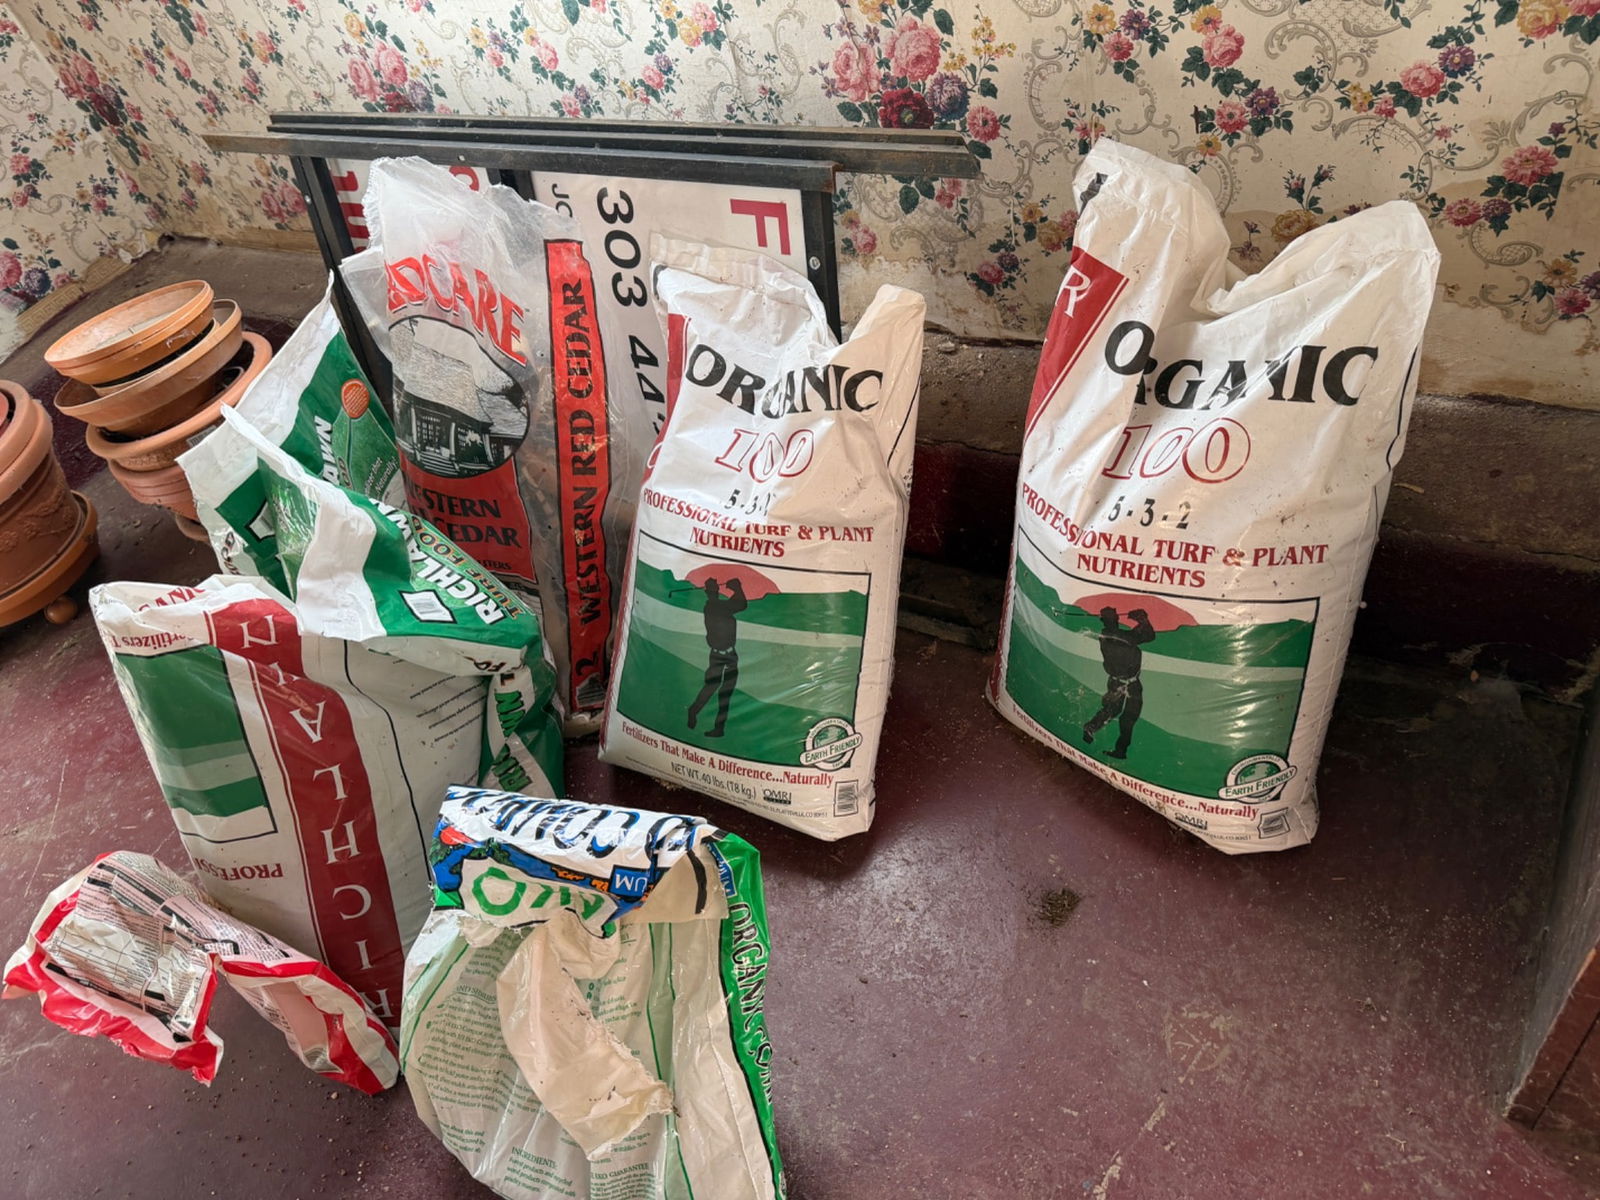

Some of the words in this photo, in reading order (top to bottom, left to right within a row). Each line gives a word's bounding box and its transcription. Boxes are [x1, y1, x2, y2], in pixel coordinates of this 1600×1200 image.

[596, 186, 649, 308] 303
[562, 278, 595, 398] CEDAR
[568, 410, 597, 477] RED
[714, 428, 815, 483] 100
[1101, 417, 1252, 484] 100
[410, 515, 468, 567] FOOD
[643, 487, 737, 533] PROFESSIONAL
[745, 522, 792, 537] TURF
[797, 524, 815, 541] &
[818, 526, 875, 543] PLANT
[689, 526, 786, 558] NUTRIENTS
[1022, 483, 1145, 557] PROFESSIONAL
[1152, 539, 1216, 564] TURF
[1221, 548, 1246, 567] &
[1251, 543, 1329, 567] PLANT
[572, 487, 602, 627] WESTERN
[1076, 553, 1207, 588] NUTRIENTS
[465, 567, 522, 620] TURF
[622, 721, 659, 749] Fertilizers
[660, 739, 680, 759] That
[682, 748, 706, 766] Make
[708, 757, 716, 769] A
[804, 750, 828, 763] EARTH
[829, 736, 861, 756] FRIENDLY
[1077, 750, 1107, 776] Make
[1110, 771, 1119, 782] A
[1225, 785, 1253, 797] EARTH
[1256, 768, 1294, 791] FRIENDLY
